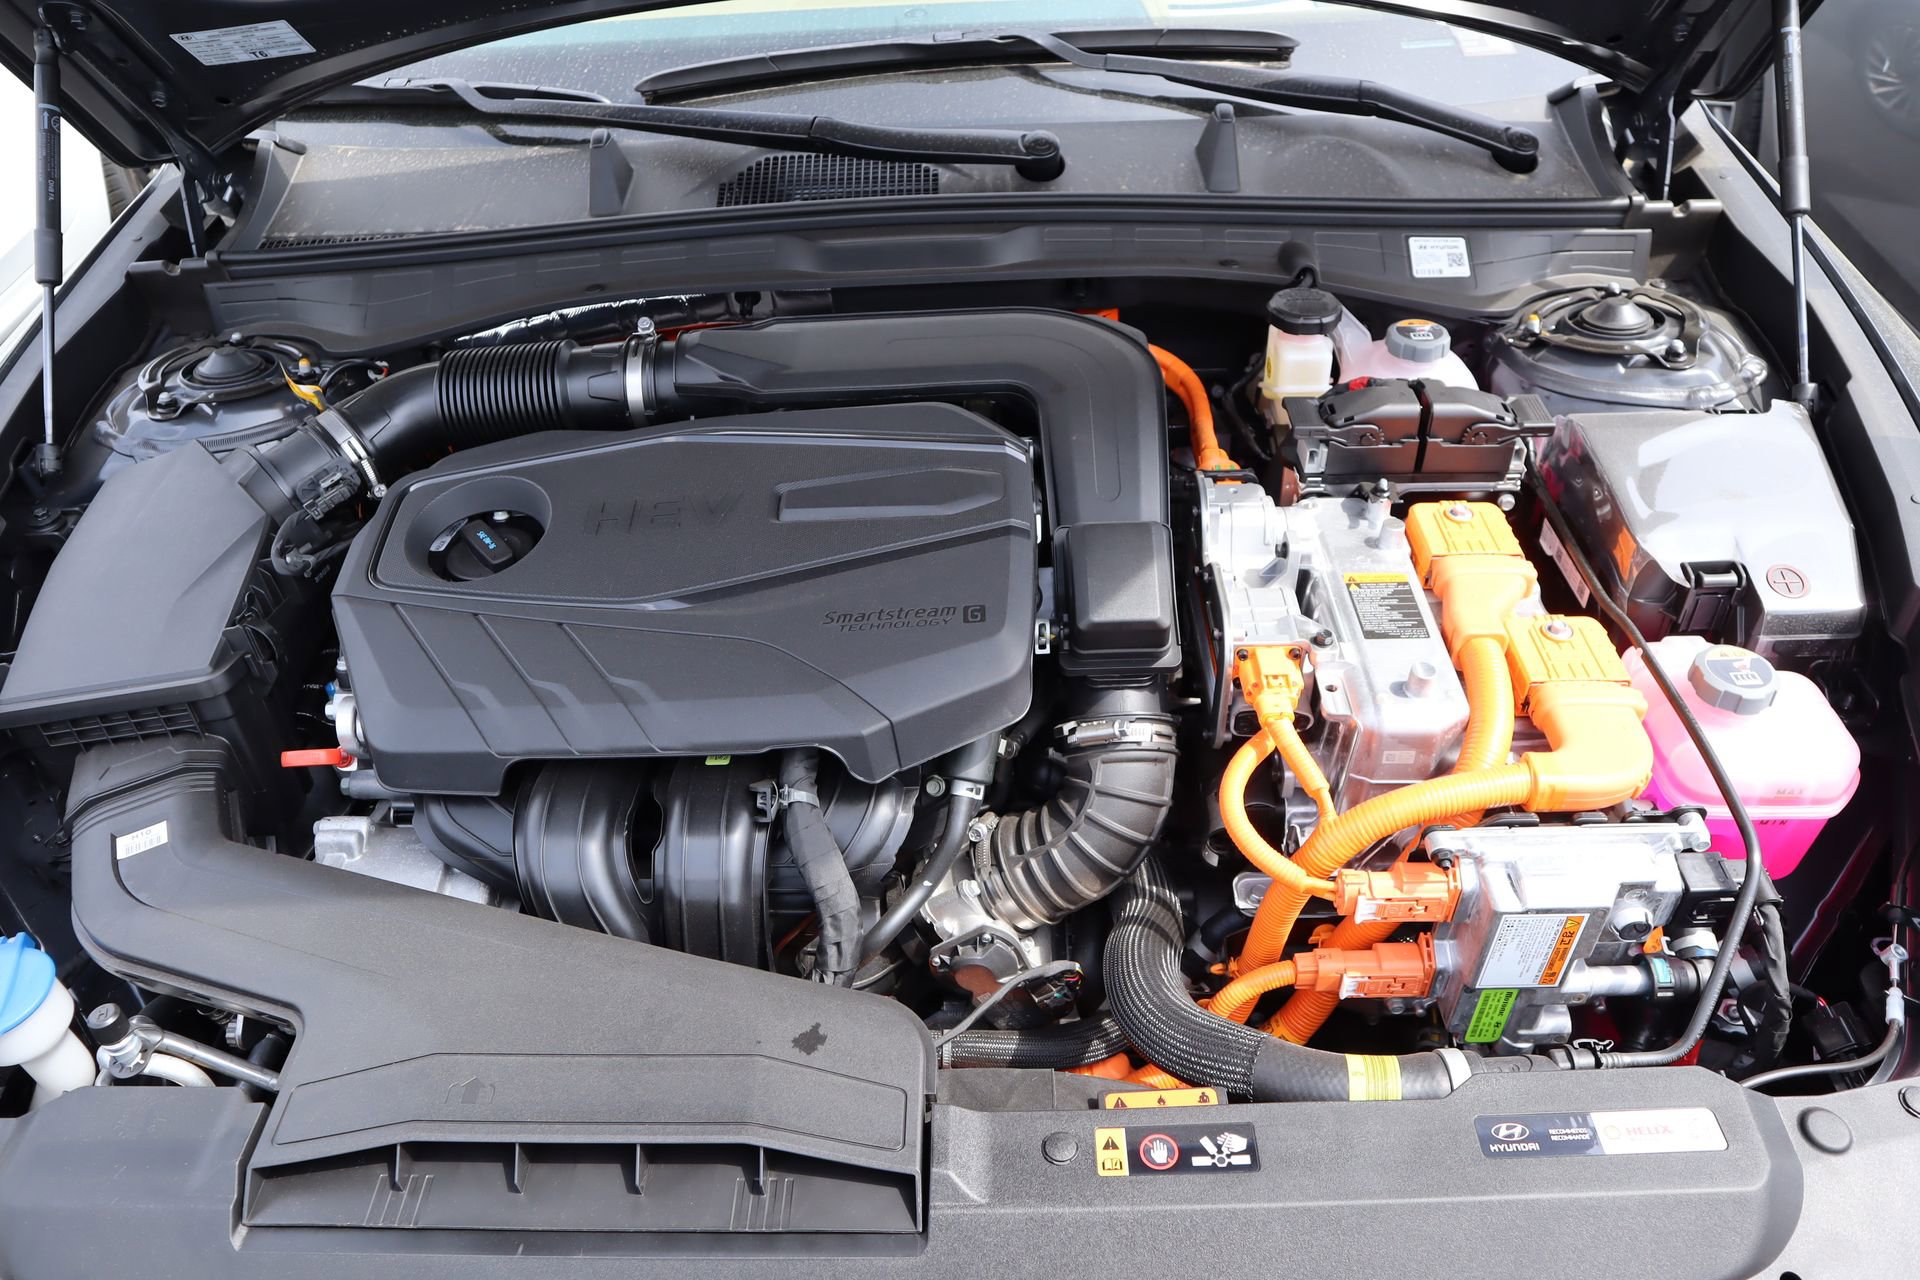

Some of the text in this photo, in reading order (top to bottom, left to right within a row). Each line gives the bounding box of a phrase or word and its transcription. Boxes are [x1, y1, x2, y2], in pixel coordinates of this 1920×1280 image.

[249, 51, 269, 59] T6
[584, 494, 745, 536] HEV
[823, 605, 985, 625] Smartstream G
[839, 617, 952, 632] TECHNOLOGY
[1559, 930, 1575, 946] 경고
[1625, 1126, 1673, 1136] HELIX
[1489, 1142, 1540, 1152] HYUNDAI
